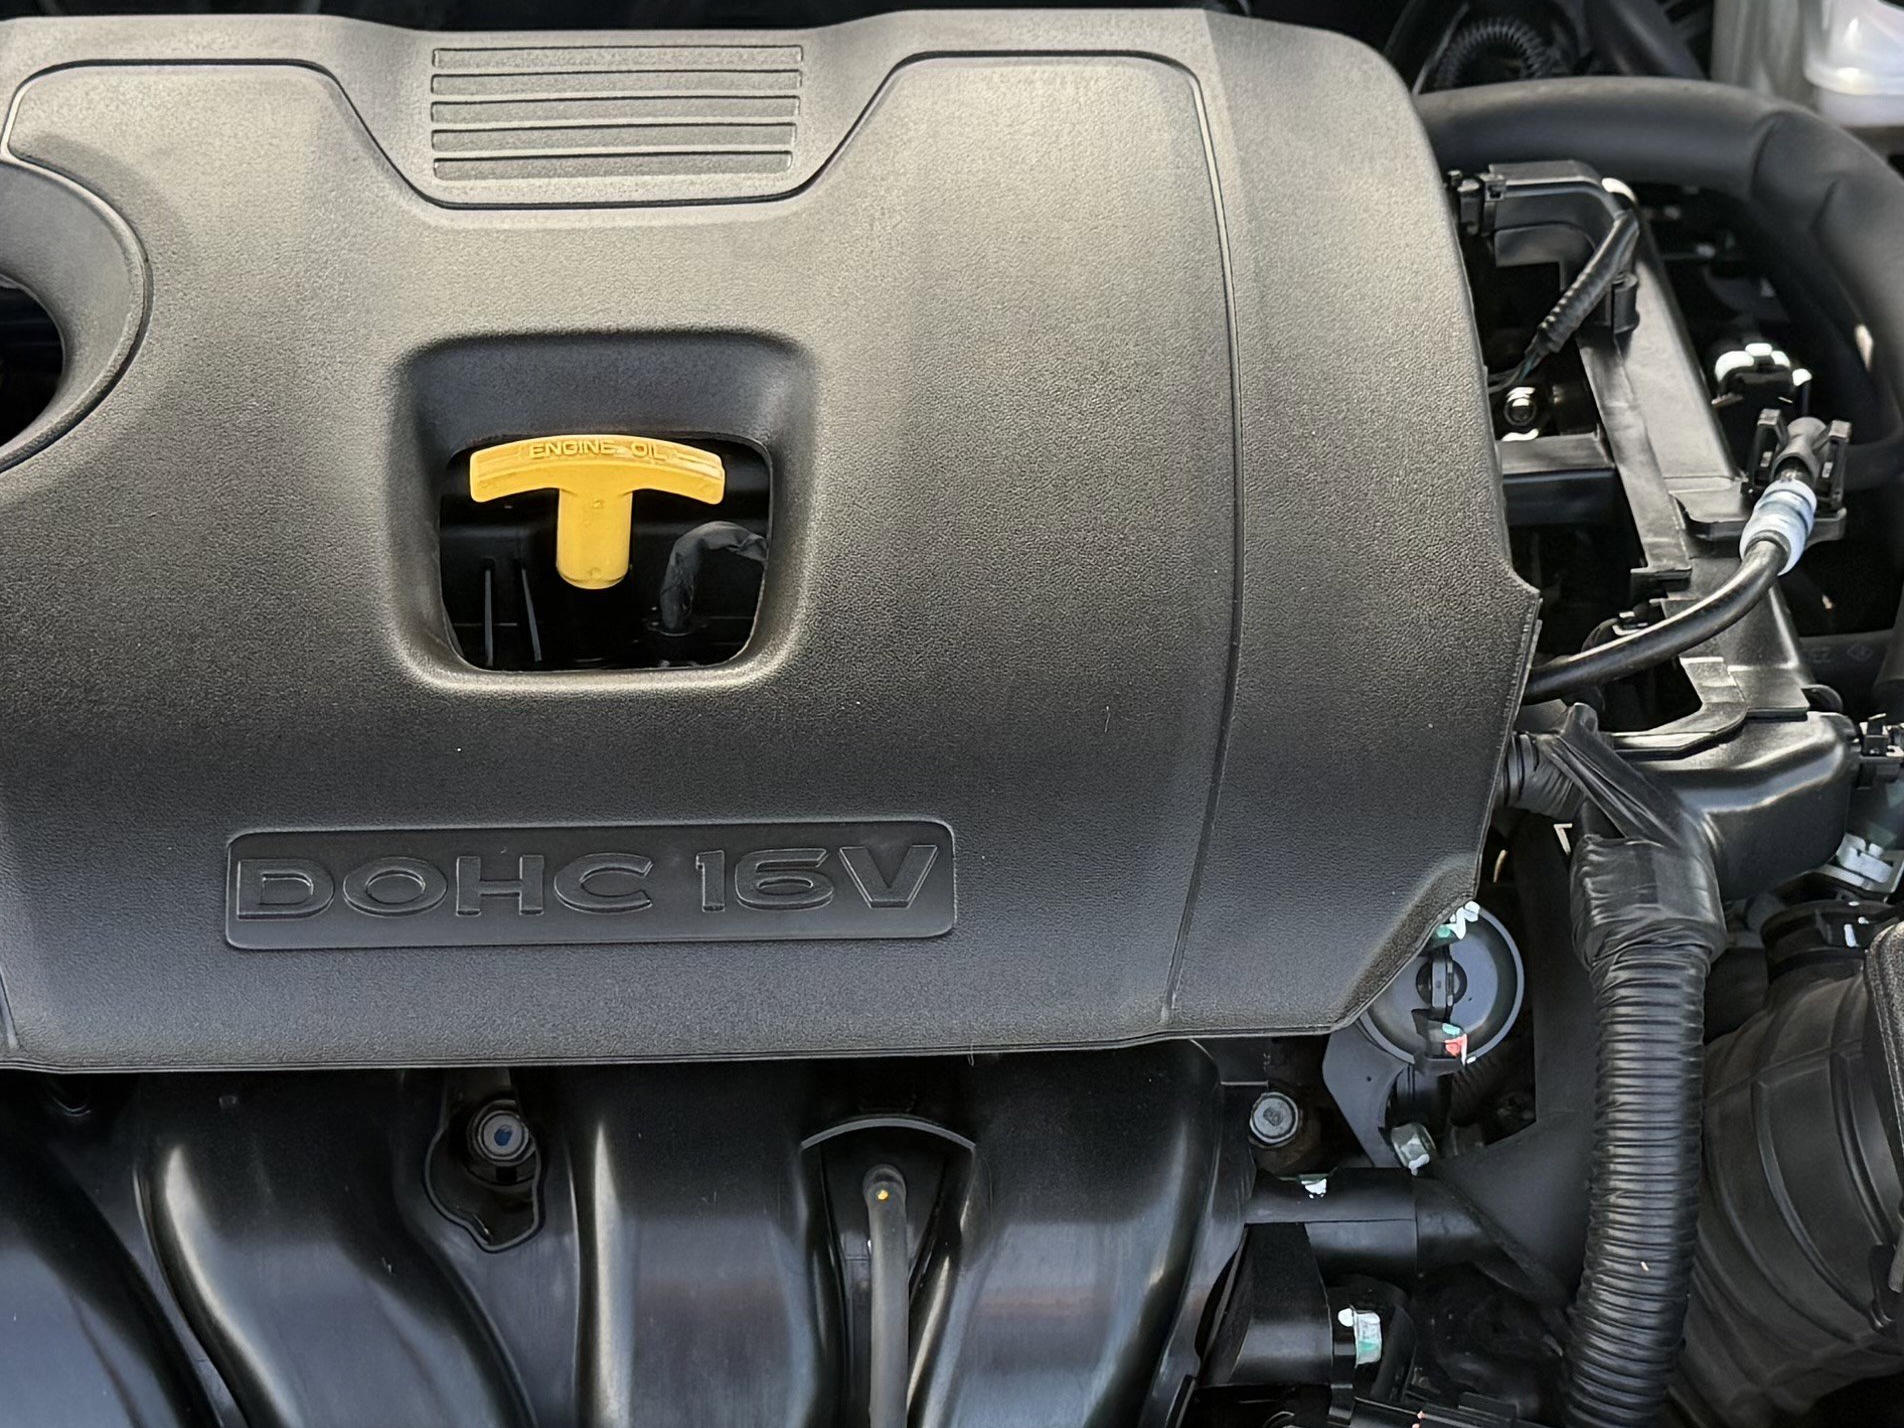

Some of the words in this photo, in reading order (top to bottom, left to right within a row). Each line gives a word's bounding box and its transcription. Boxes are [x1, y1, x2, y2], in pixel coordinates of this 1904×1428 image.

[530, 439, 618, 460] ENGINE
[631, 440, 668, 461] OIL
[234, 852, 655, 920] DOHC
[695, 844, 940, 913] 16V
